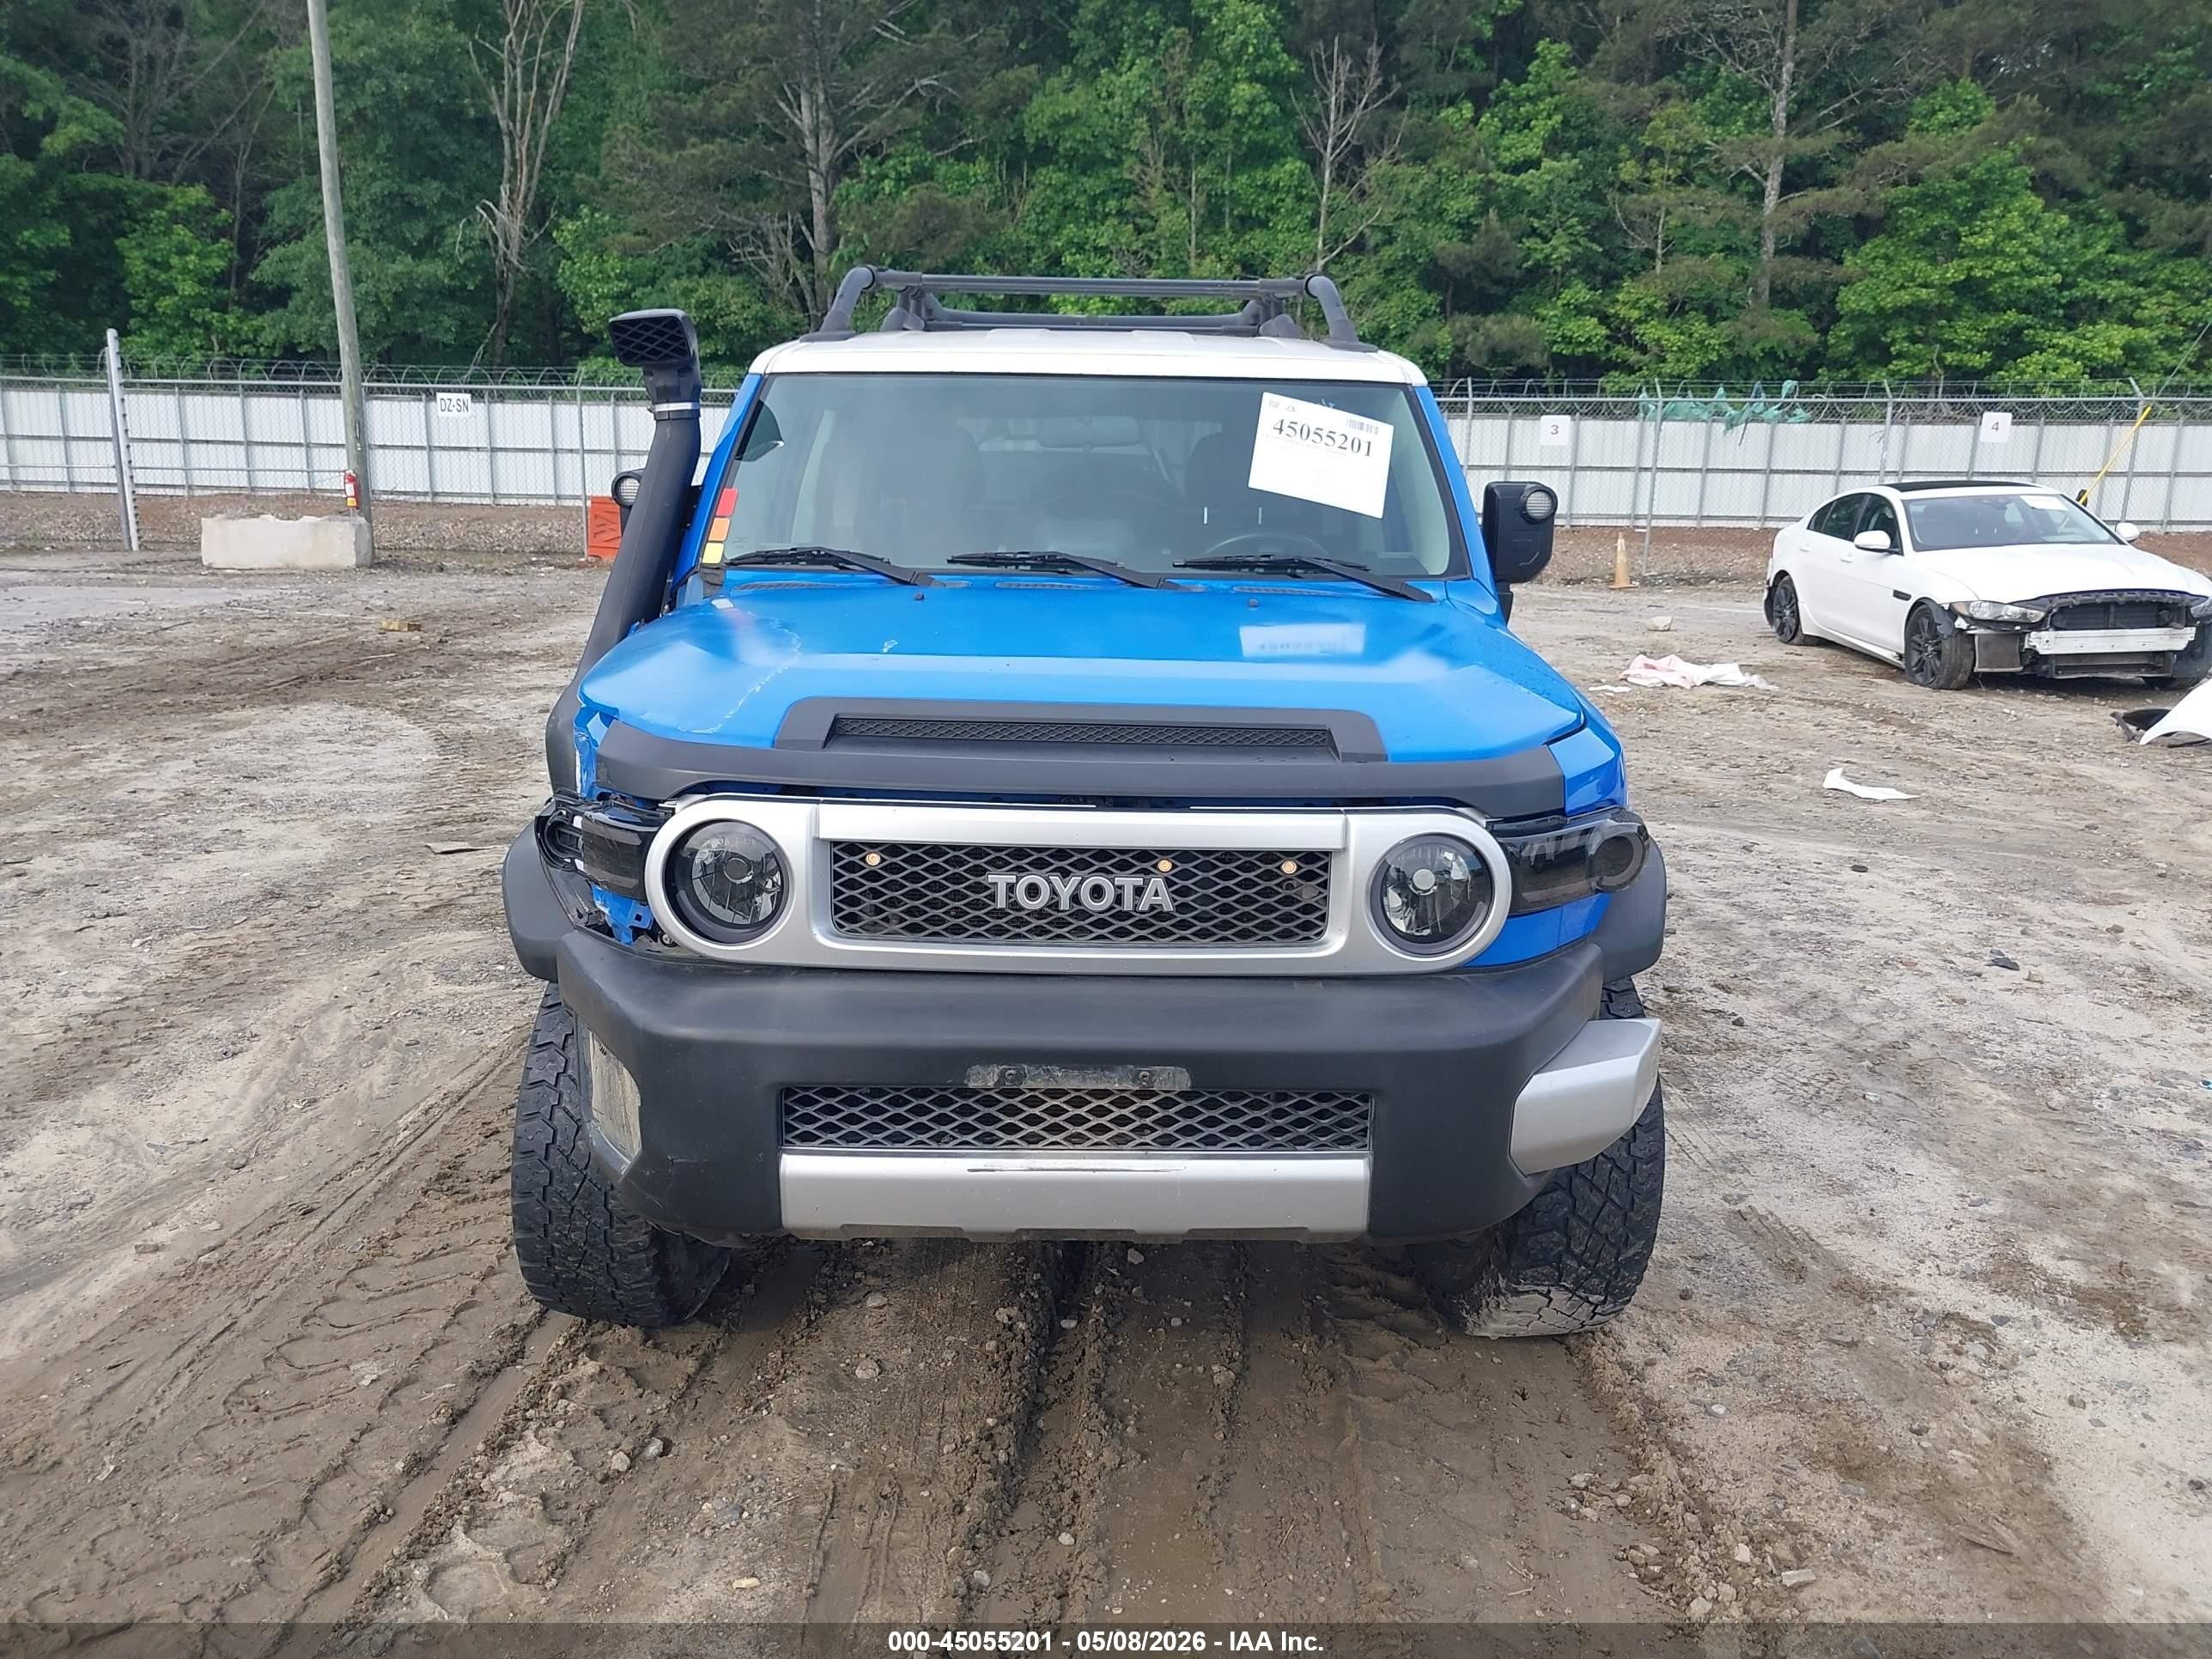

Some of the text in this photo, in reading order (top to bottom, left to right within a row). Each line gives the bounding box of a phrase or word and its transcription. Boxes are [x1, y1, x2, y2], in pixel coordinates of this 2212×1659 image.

[440, 398, 470, 413] DZ-SN
[1550, 424, 1559, 435] 3
[1991, 421, 2000, 432] 4
[1272, 418, 1372, 458] 45055201
[987, 873, 1175, 912] TOYOTA
